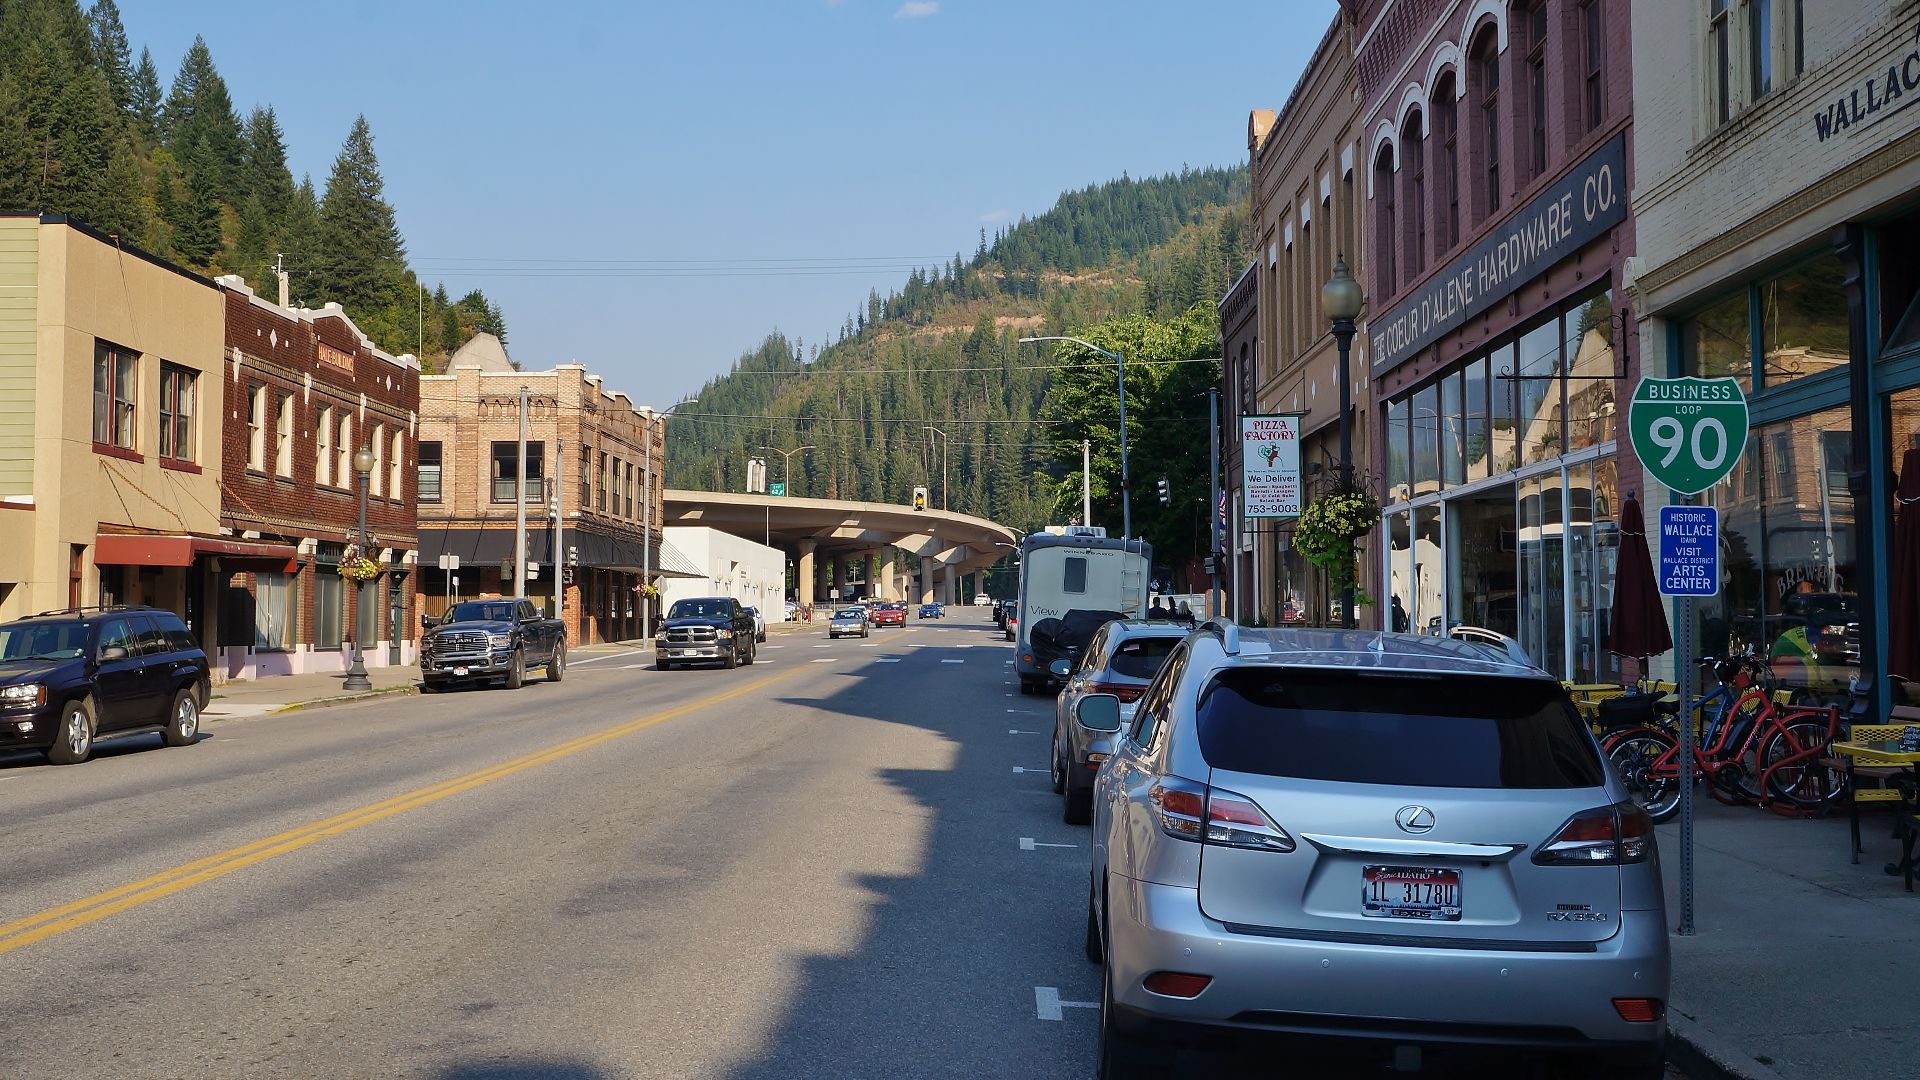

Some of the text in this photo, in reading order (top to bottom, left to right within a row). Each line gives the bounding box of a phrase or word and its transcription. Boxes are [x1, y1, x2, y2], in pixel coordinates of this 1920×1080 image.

[1373, 164, 1617, 366] THE COEUR D'ALENE HARDWARE CO.
[1649, 384, 1731, 400] BUSINESS
[1675, 405, 1702, 415] LOOP
[1252, 420, 1288, 430] PIZZA
[1244, 430, 1296, 441] FACTORY
[1649, 416, 1728, 470] 90
[1248, 474, 1296, 483] We Deliver
[1247, 504, 1298, 514] 753-9003
[1670, 513, 1706, 523] HISTORIC
[1664, 524, 1713, 537] WALLACE
[1675, 546, 1702, 557] VISIT
[1672, 565, 1705, 577] ARTS
[1666, 577, 1711, 589] CENTER
[1030, 605, 1059, 617] View
[1397, 871, 1430, 880] IDAHO
[1371, 881, 1453, 905] 1L 3178U
[1546, 911, 1608, 922] RX 350
